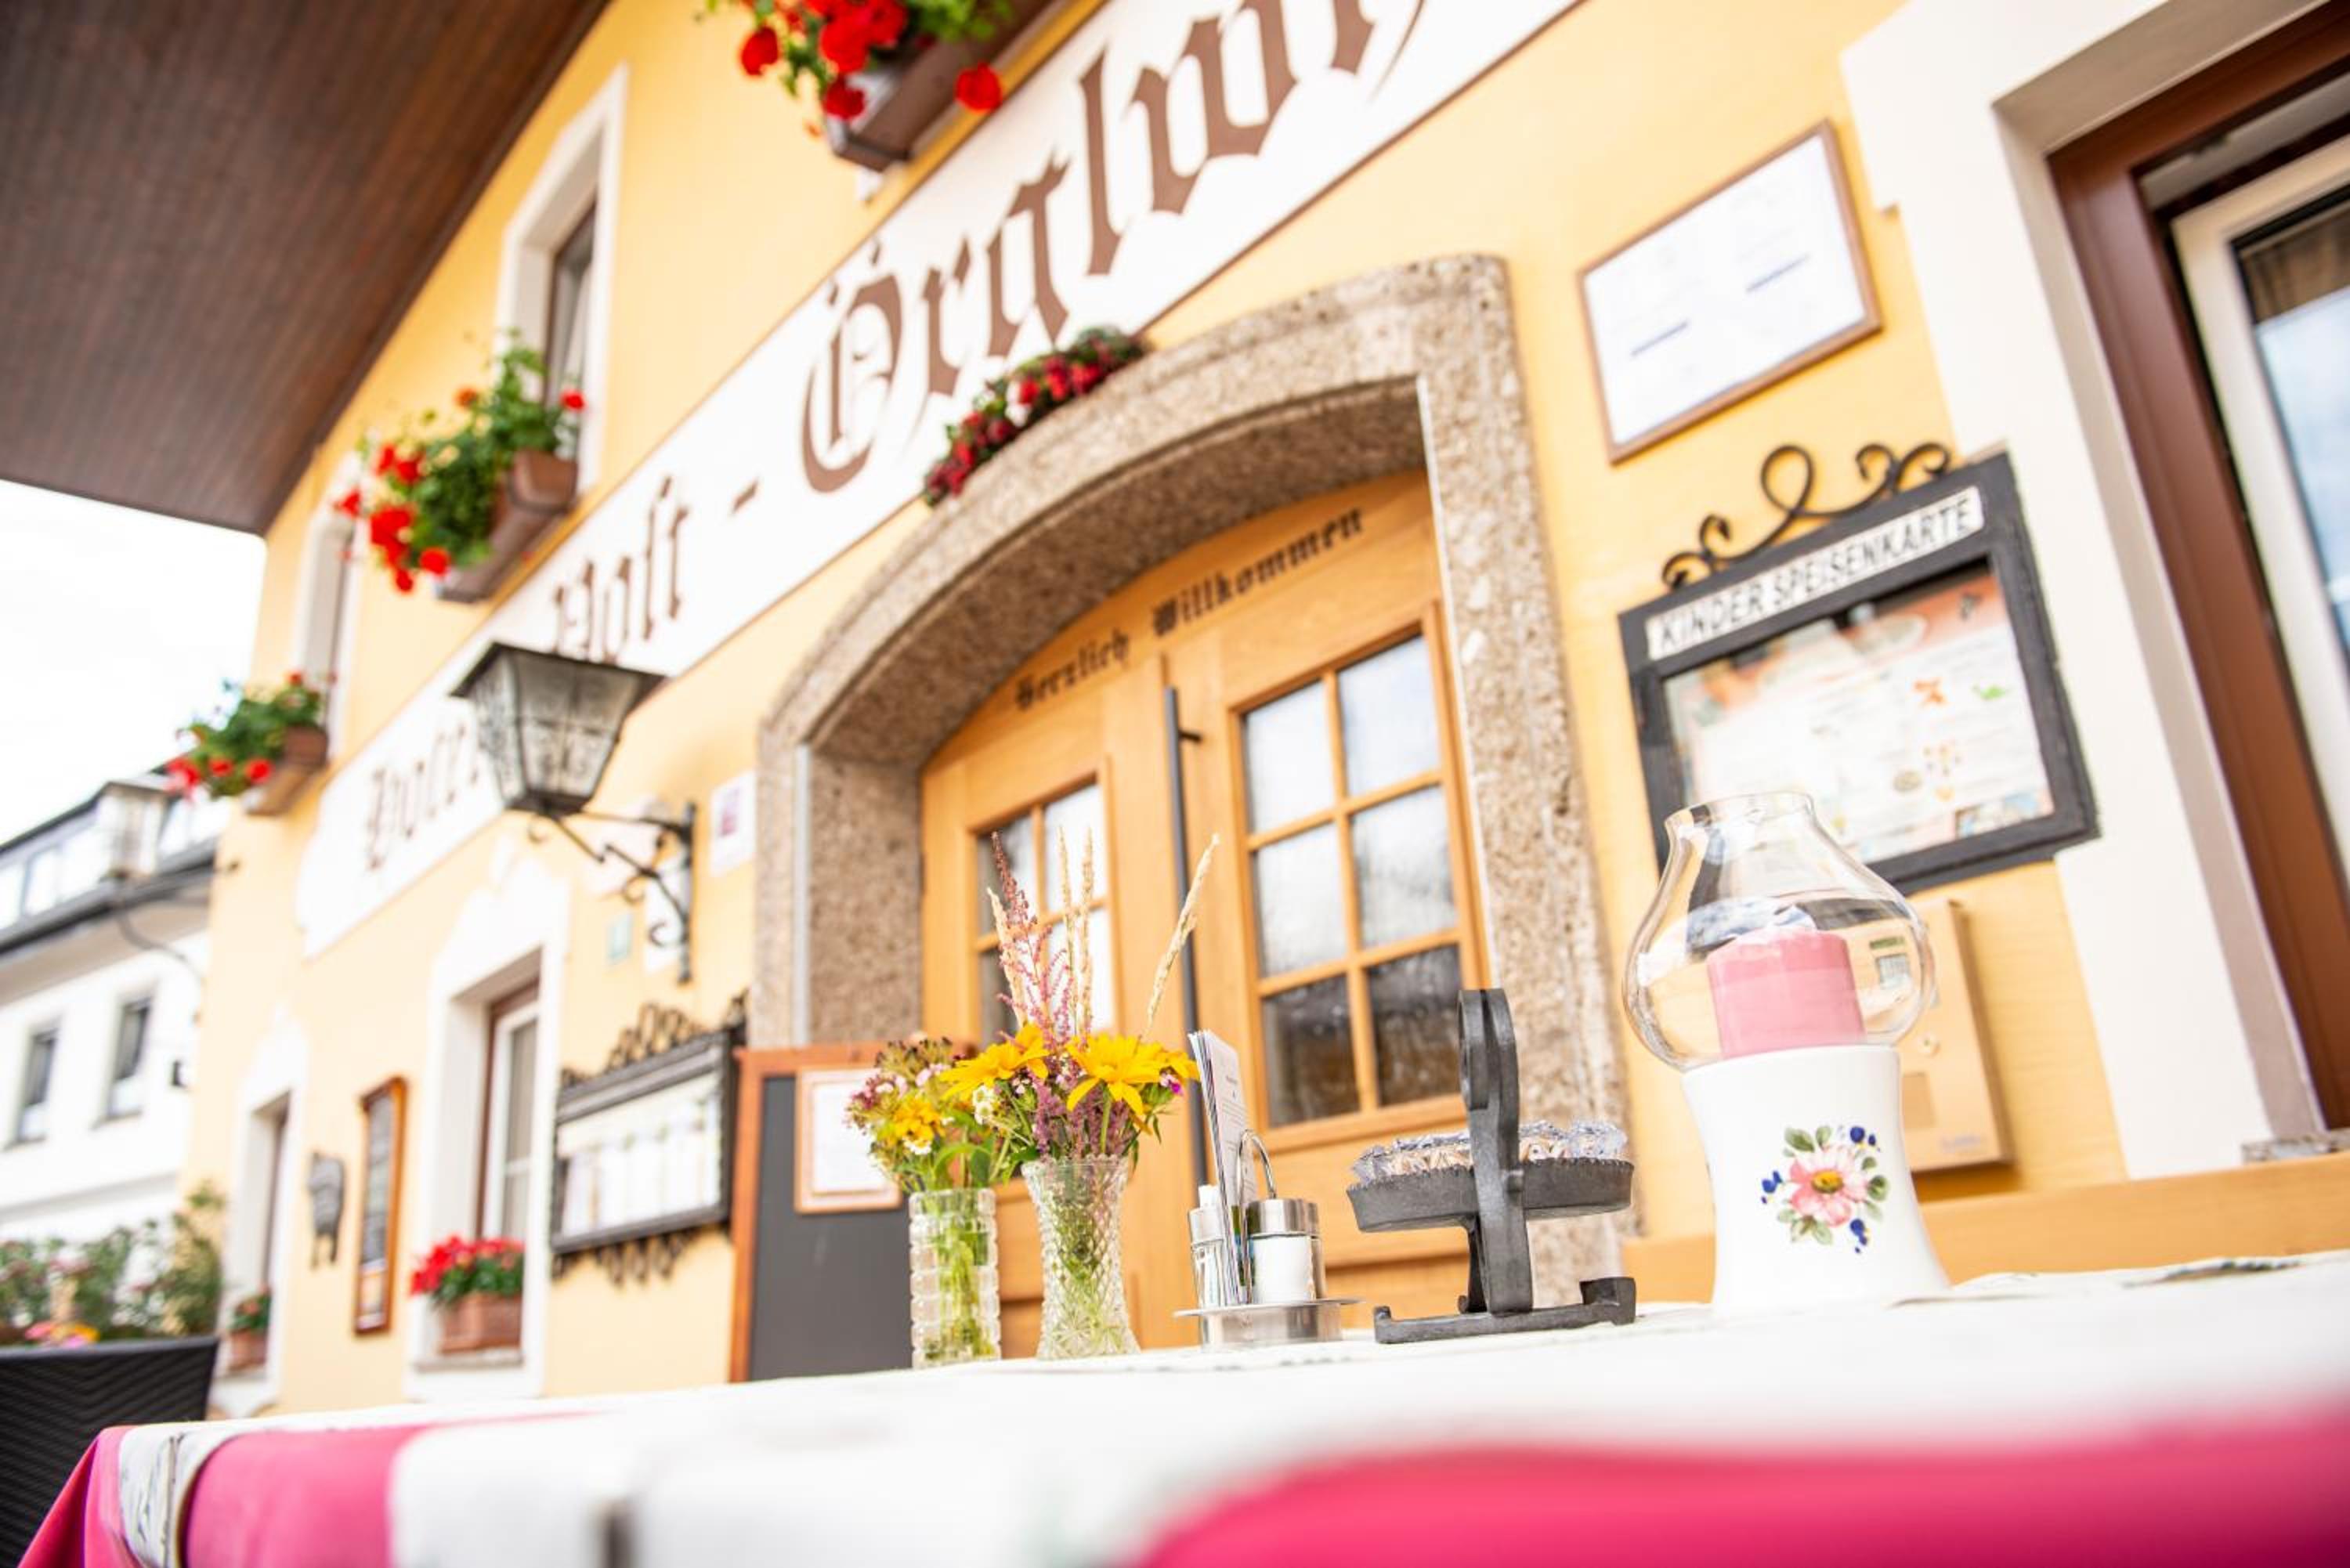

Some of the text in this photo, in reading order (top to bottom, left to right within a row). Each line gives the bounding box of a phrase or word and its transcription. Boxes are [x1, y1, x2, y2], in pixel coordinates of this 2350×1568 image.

[1015, 508, 1362, 711] Herzlich Willkommen
[1658, 497, 1972, 653] KINDER SPEISENKARTE
